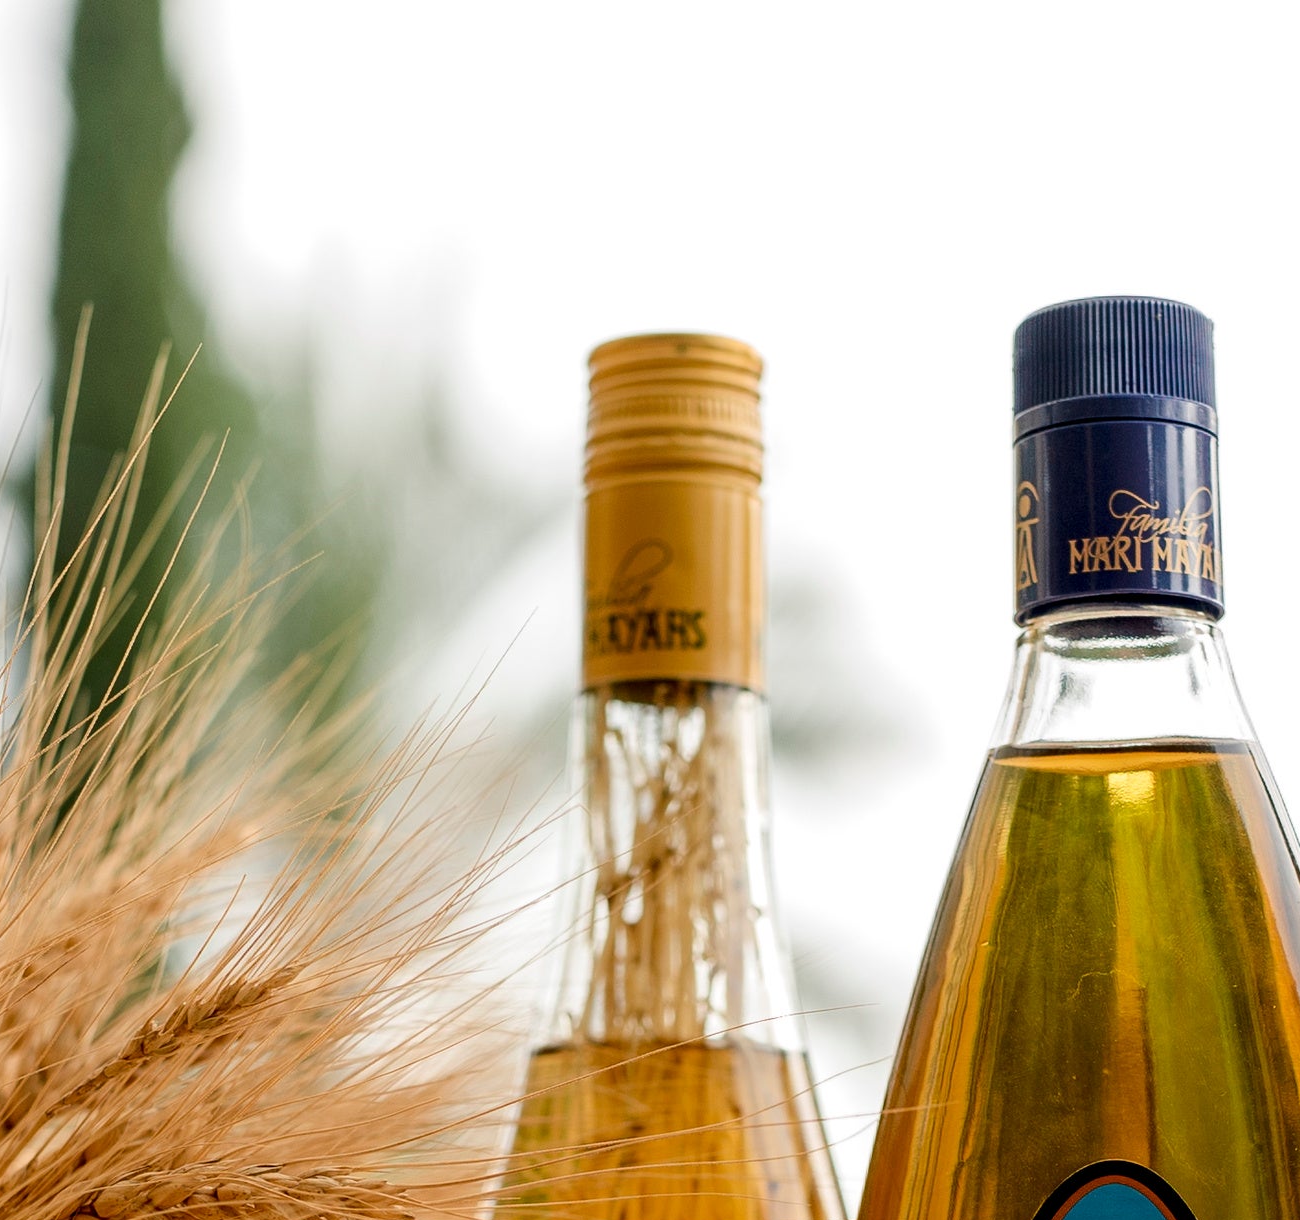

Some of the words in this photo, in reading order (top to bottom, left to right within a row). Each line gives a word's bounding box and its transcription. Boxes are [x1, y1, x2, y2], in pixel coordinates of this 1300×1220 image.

[1069, 536, 1143, 574] MARI
[1153, 536, 1221, 583] MAYA
[587, 609, 708, 654] AYANS
